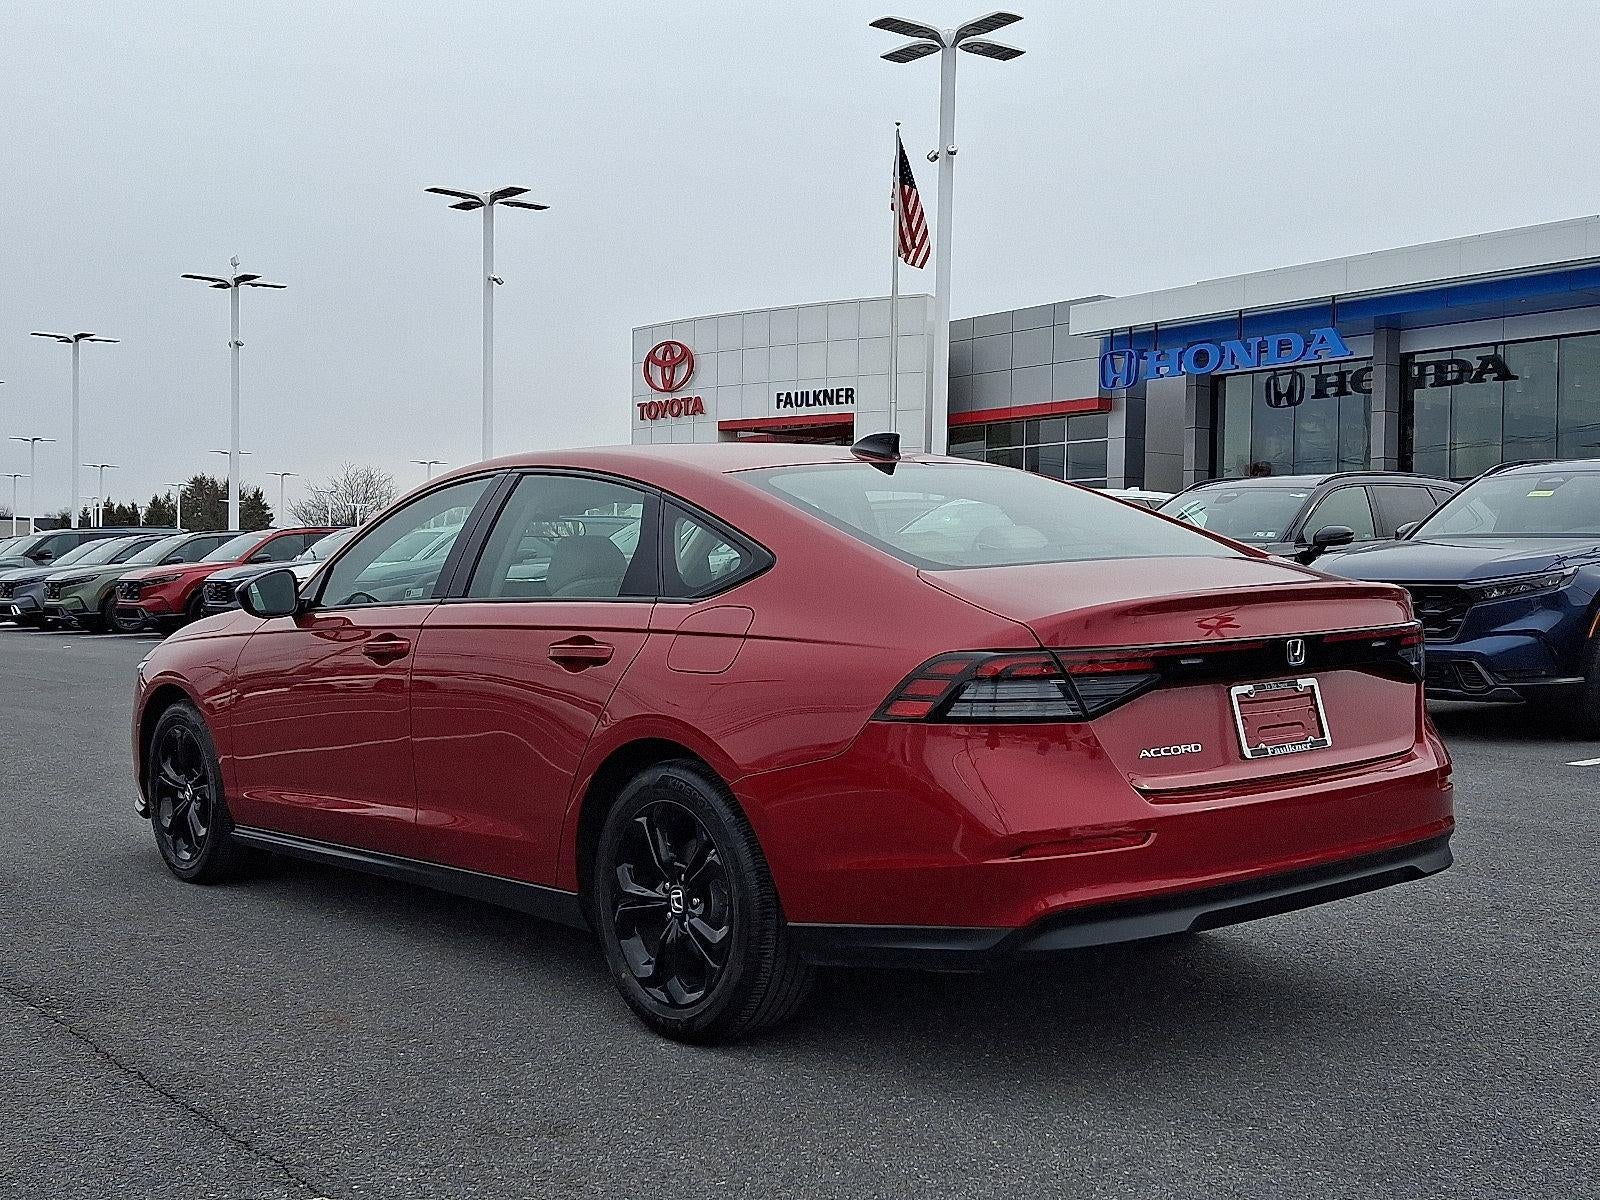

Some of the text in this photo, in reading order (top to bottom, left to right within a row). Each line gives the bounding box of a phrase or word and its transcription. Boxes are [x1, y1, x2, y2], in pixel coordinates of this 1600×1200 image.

[1144, 326, 1354, 380] HONDA
[637, 396, 705, 421] TOYOTA
[776, 387, 855, 410] FAULKNER
[1139, 743, 1202, 759] ACCORD
[1267, 741, 1312, 756] Faulkner
